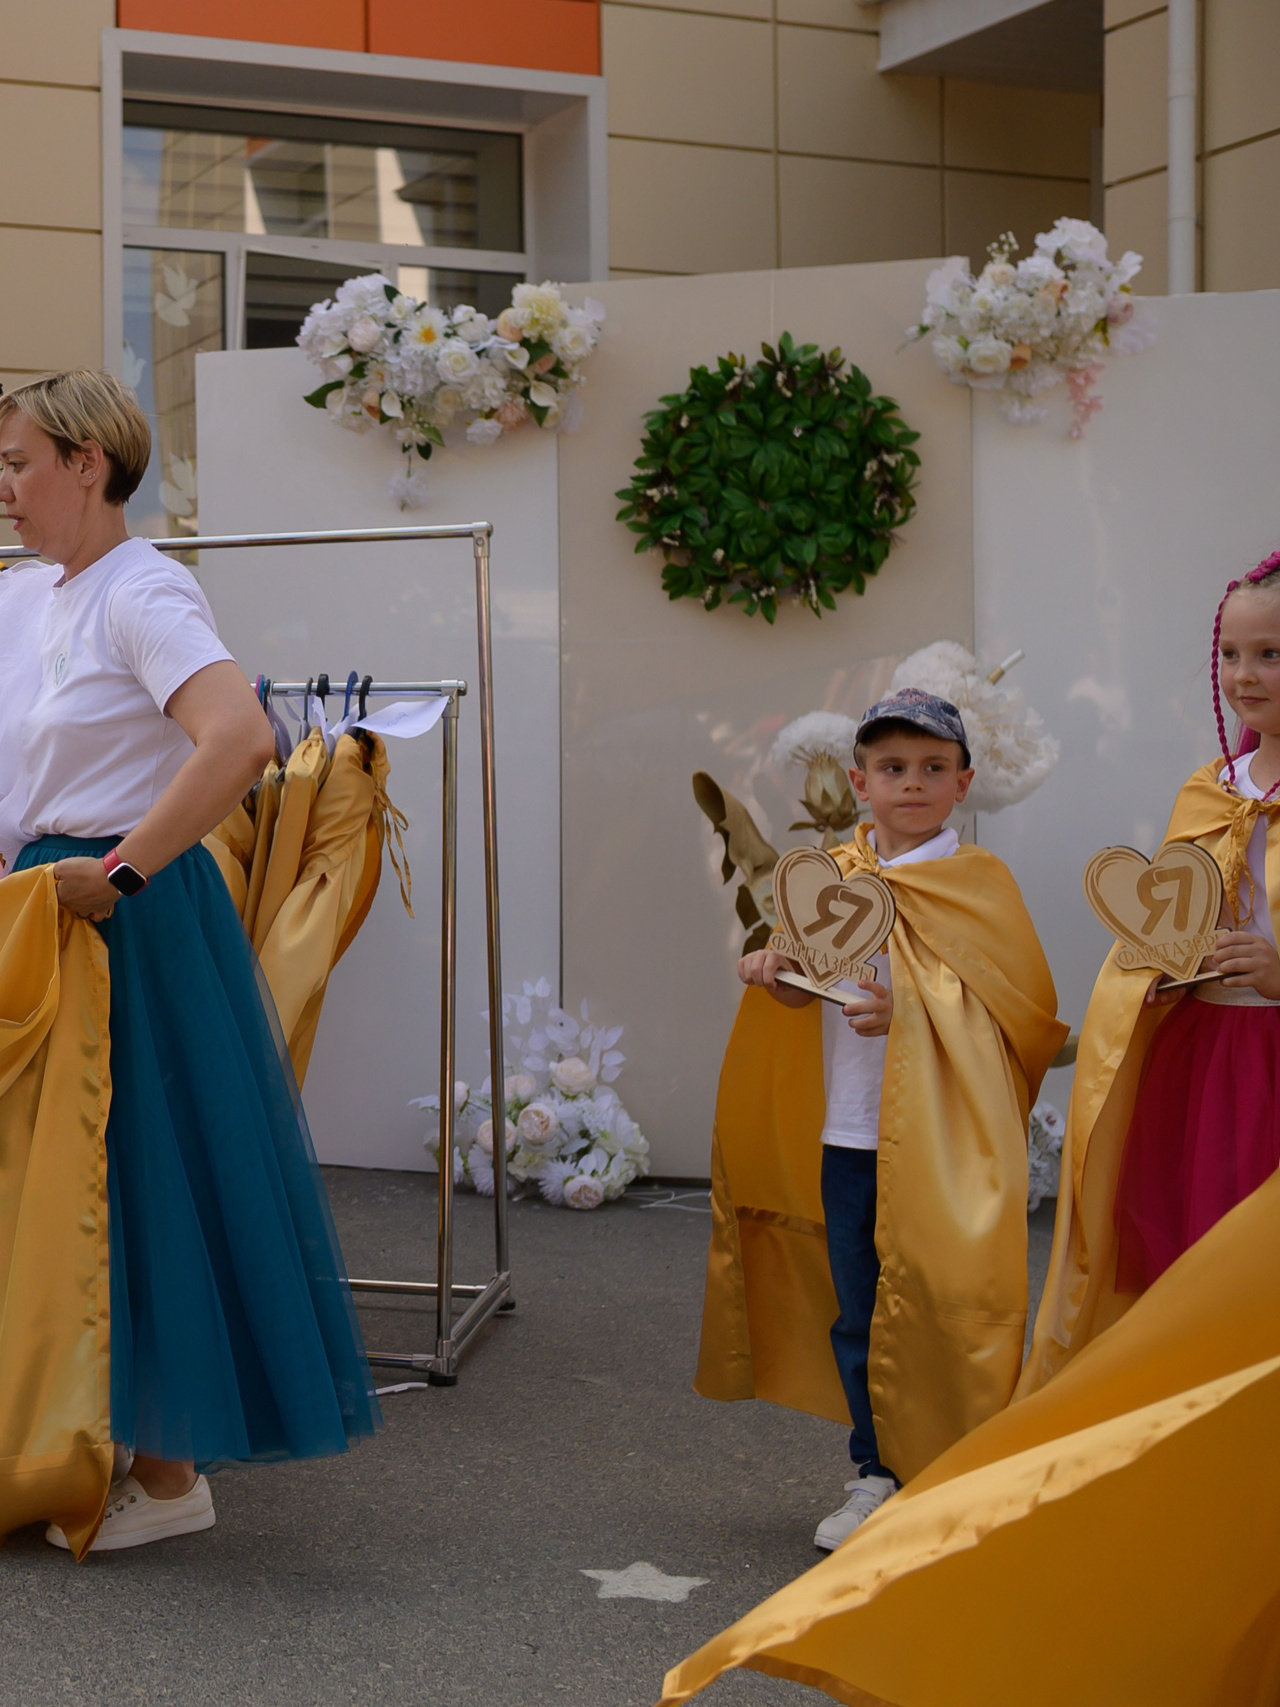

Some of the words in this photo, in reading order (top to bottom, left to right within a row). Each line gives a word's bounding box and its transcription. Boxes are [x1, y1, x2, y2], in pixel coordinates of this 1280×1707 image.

[803, 884, 874, 950] Я
[1137, 865, 1194, 936] Я
[771, 935, 873, 981] ФАНТАЗЁРЫ
[1117, 933, 1220, 967] ФАНТАЗЁР
